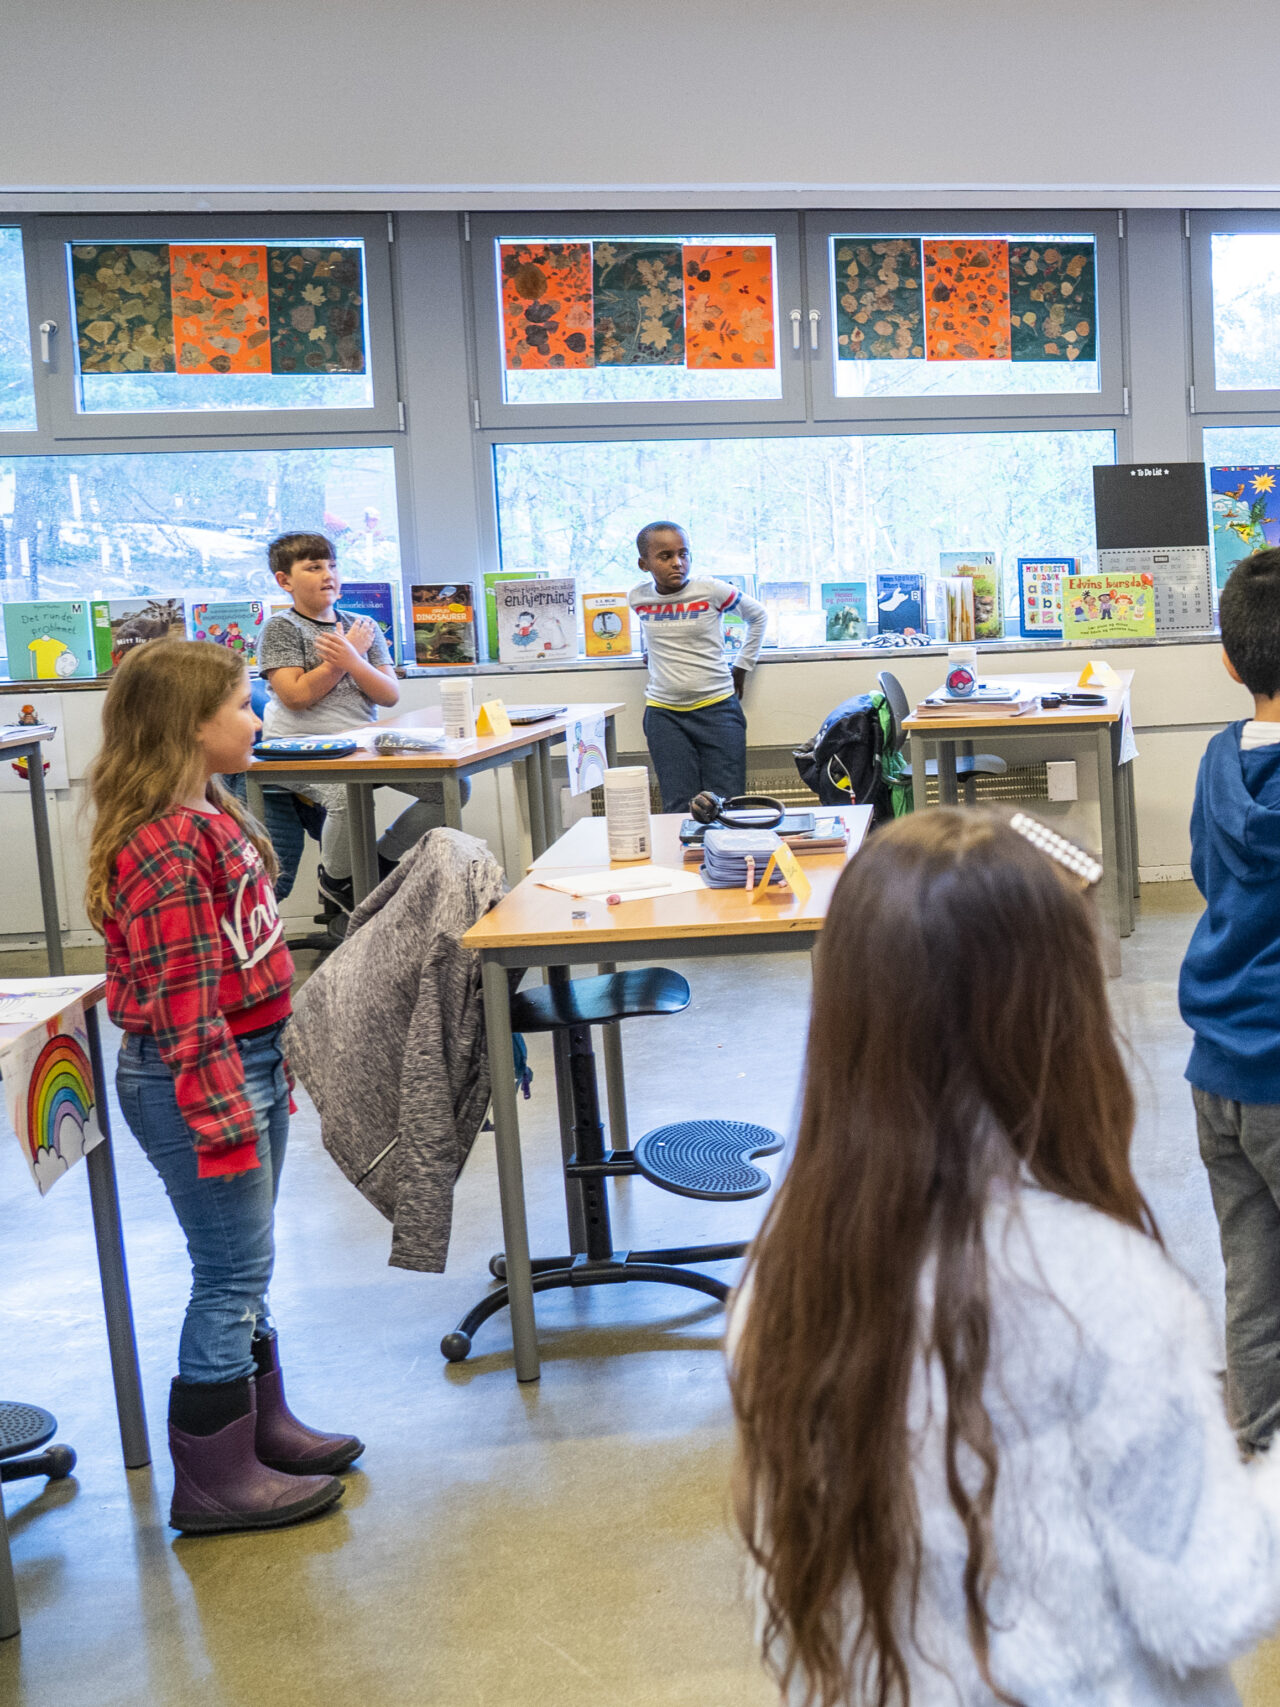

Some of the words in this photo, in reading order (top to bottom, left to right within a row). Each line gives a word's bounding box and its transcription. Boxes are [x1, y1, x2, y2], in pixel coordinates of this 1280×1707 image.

[1069, 577, 1102, 590] Edvins
[251, 603, 260, 613] B
[1043, 597, 1052, 609] b
[72, 604, 82, 613] M
[567, 606, 575, 615] H
[635, 600, 710, 622] CHAMP
[21, 614, 40, 624] Det
[415, 612, 467, 621] DINOSAURER
